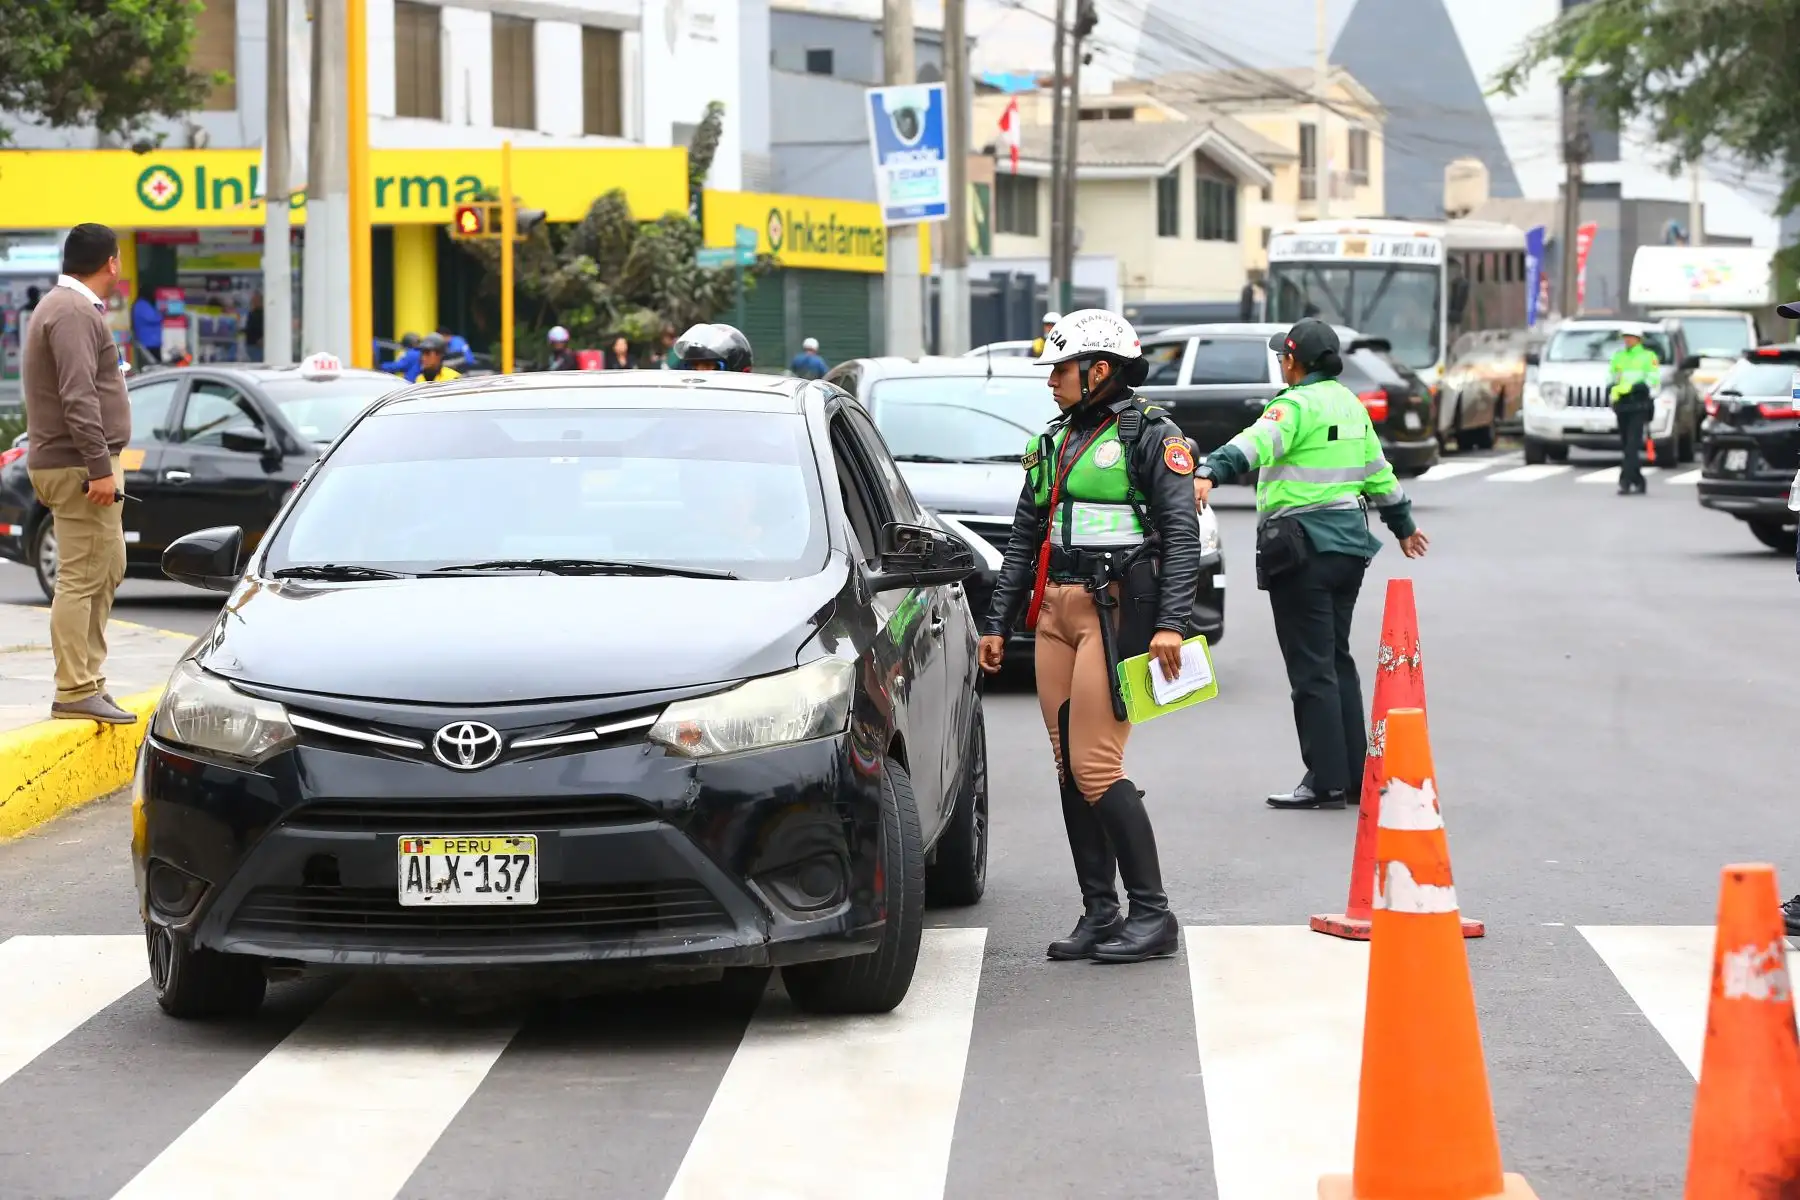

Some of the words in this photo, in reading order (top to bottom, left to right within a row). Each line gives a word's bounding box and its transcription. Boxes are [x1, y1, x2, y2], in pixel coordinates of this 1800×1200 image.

[196, 165, 482, 209] Inrma
[786, 208, 883, 257] Inkafarma
[1082, 337, 1100, 347] Lima
[445, 840, 491, 852] PERU
[407, 855, 530, 893] ALX-137
